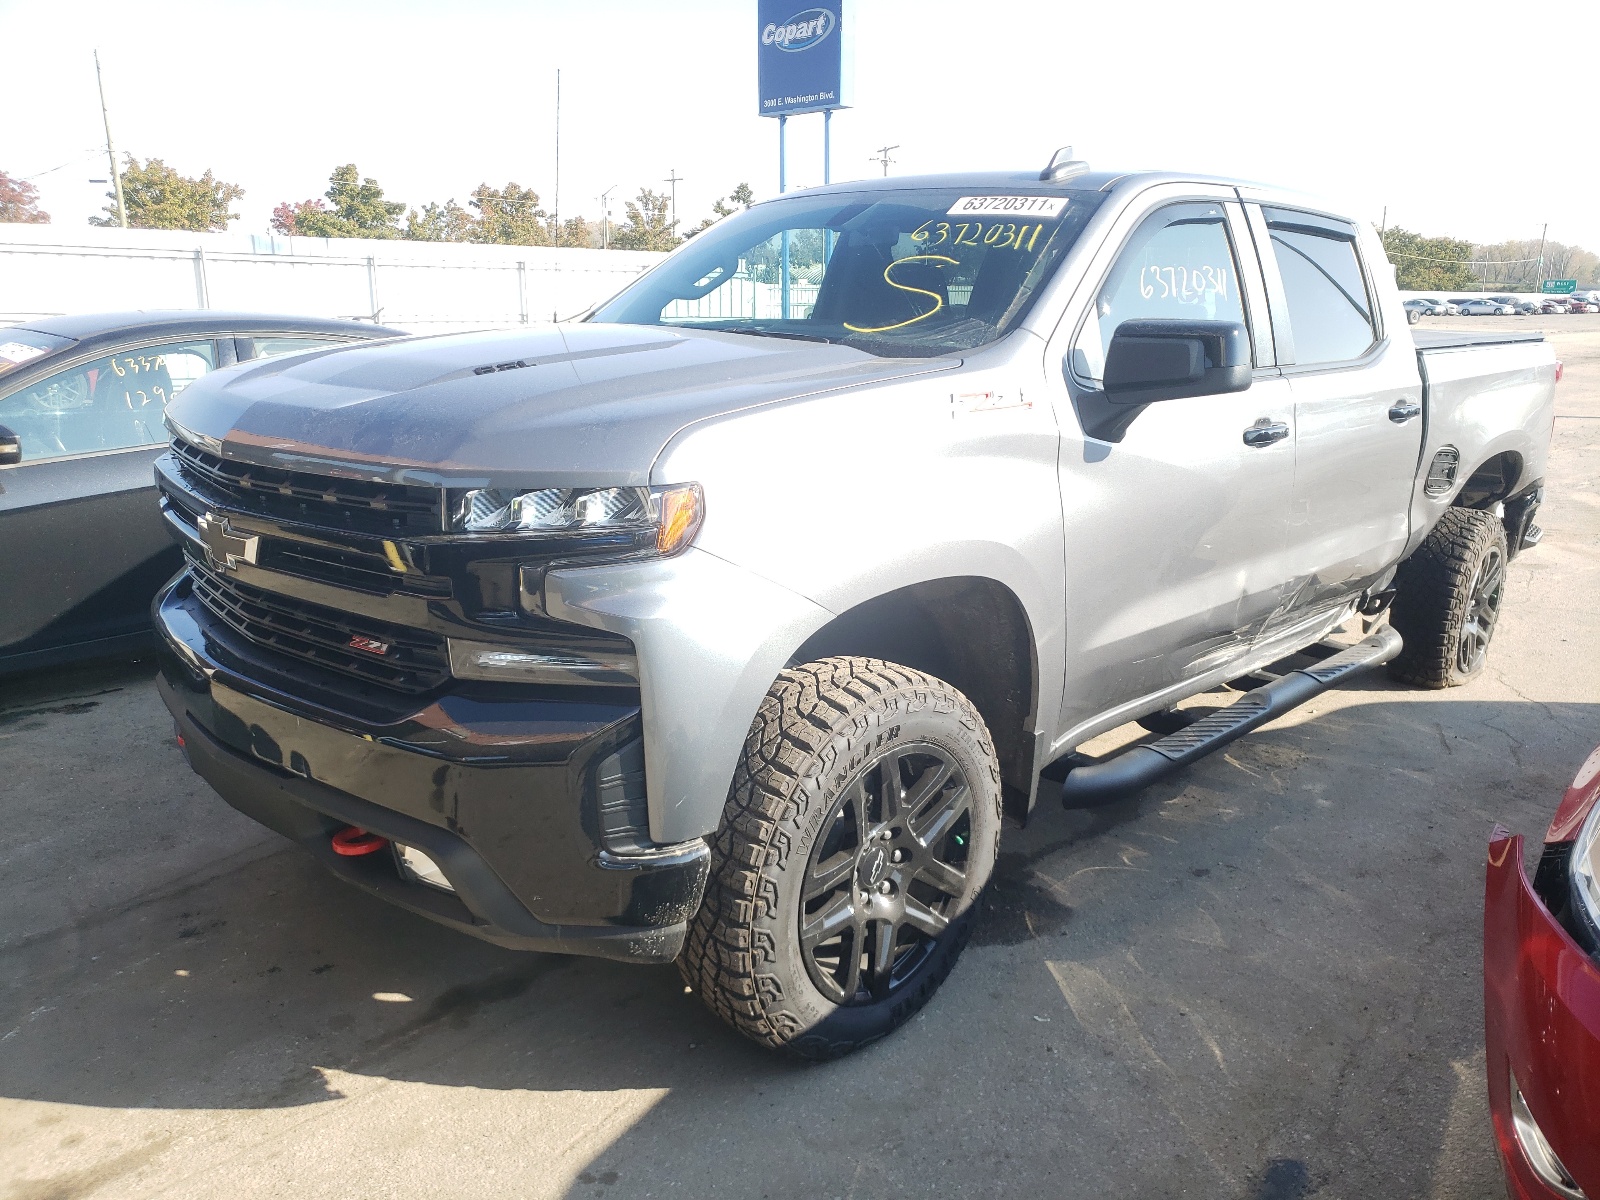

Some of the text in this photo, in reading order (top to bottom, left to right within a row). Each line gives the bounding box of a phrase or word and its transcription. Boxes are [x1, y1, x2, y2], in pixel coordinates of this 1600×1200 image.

[762, 12, 826, 46] Copart
[785, 94, 818, 105] Washington
[910, 219, 1043, 252] 63720311
[1139, 265, 1228, 301] 63720311
